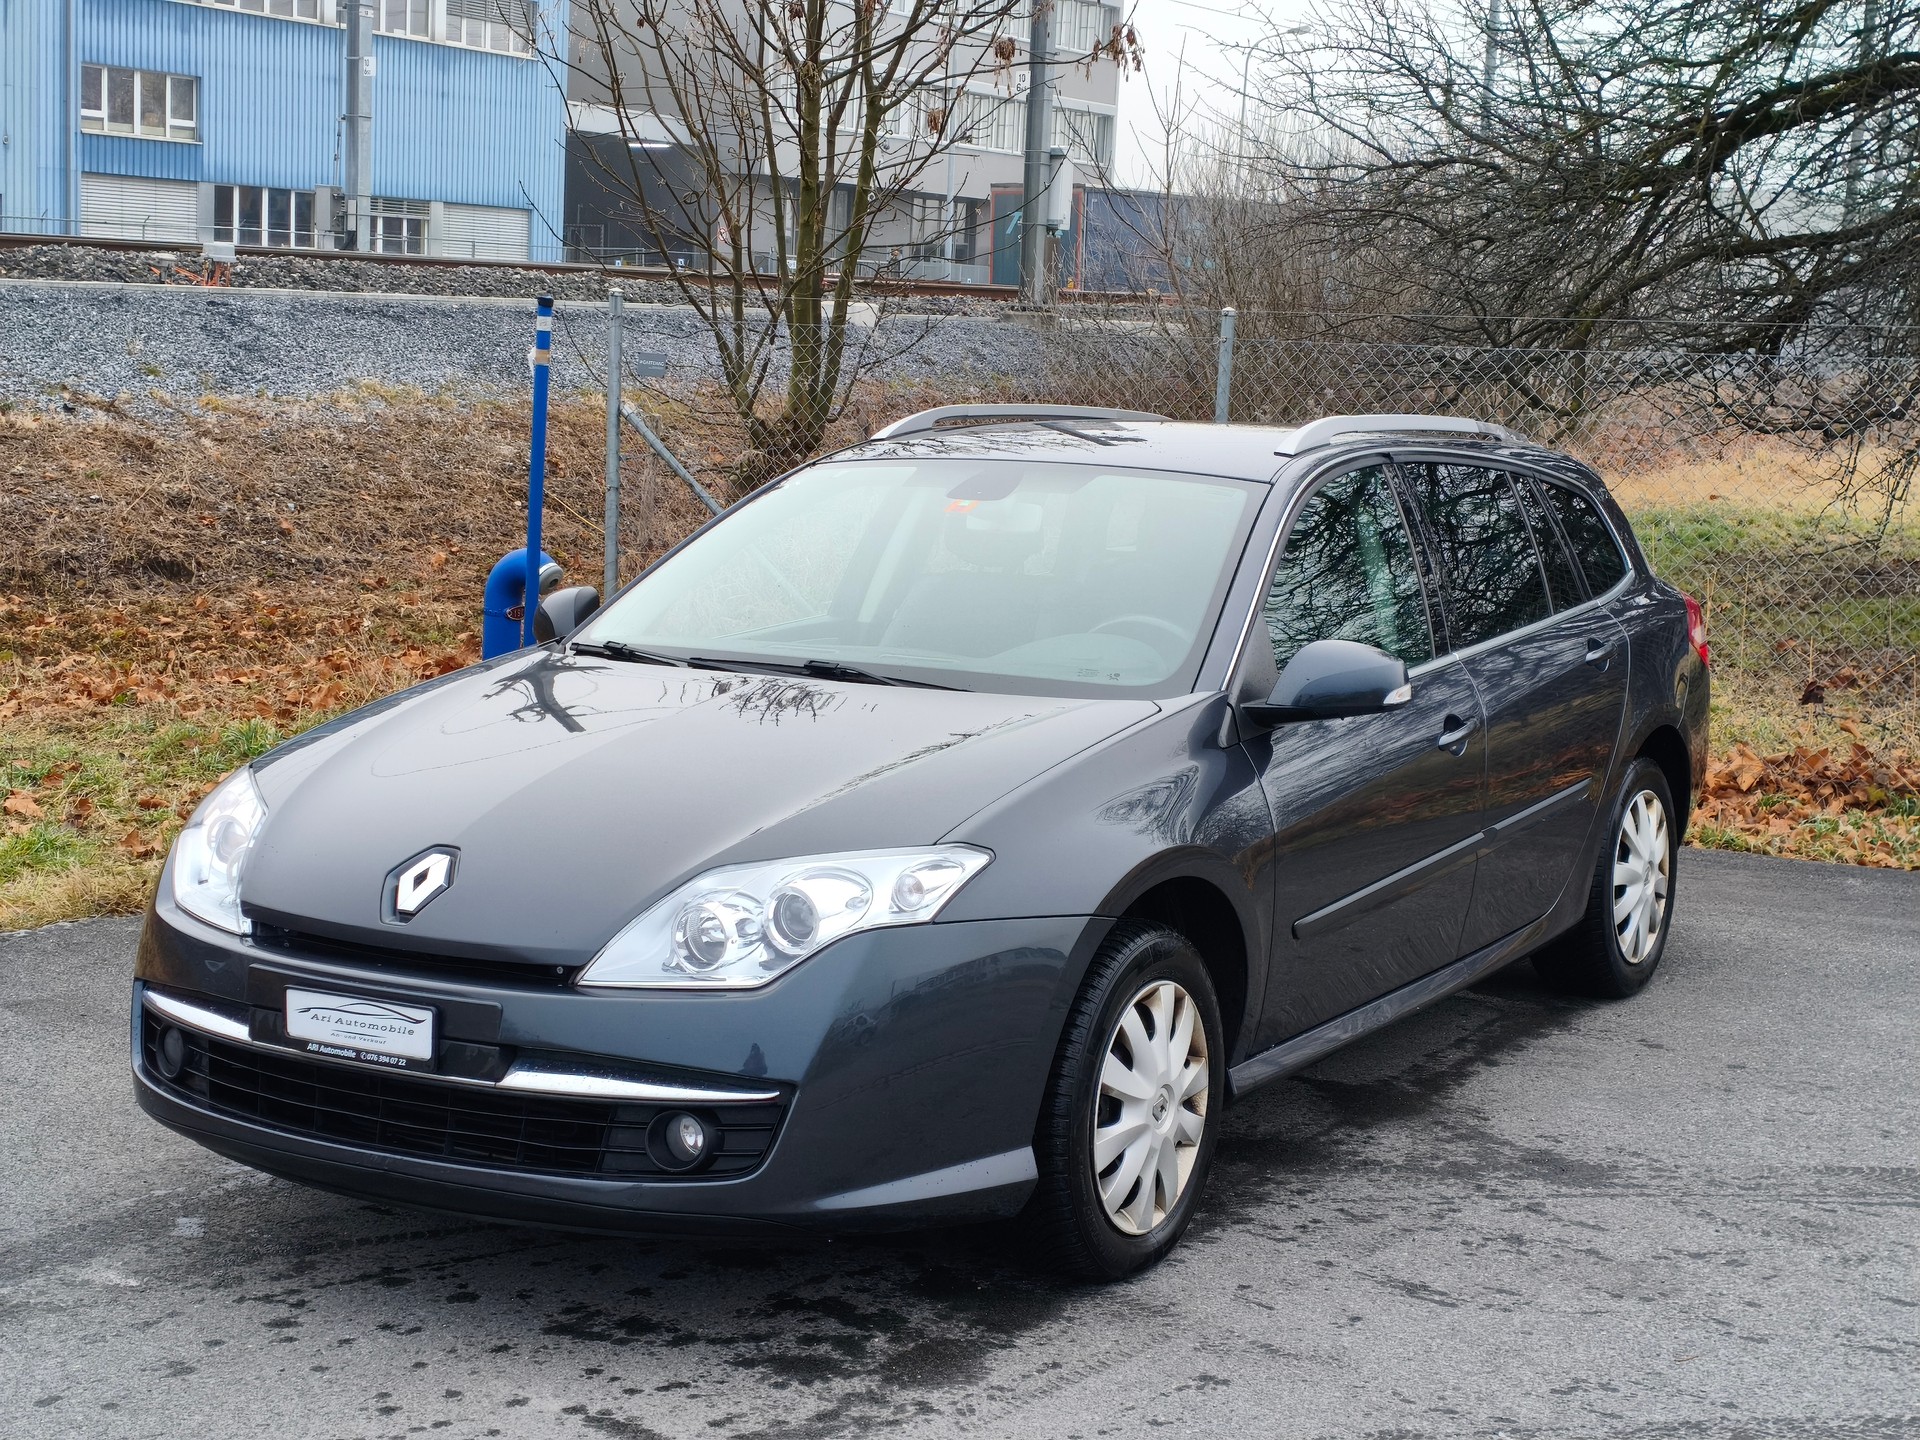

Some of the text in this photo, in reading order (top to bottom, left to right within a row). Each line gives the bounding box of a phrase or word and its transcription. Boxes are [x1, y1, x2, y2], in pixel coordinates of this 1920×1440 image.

[1018, 74, 1026, 82] 10
[311, 1013, 415, 1035] Ari Automobile
[358, 1036, 387, 1045] Verkauf
[320, 1045, 356, 1058] Automobile
[379, 1054, 390, 1063] 394
[390, 1056, 399, 1065] 07
[399, 1058, 406, 1066] 22
